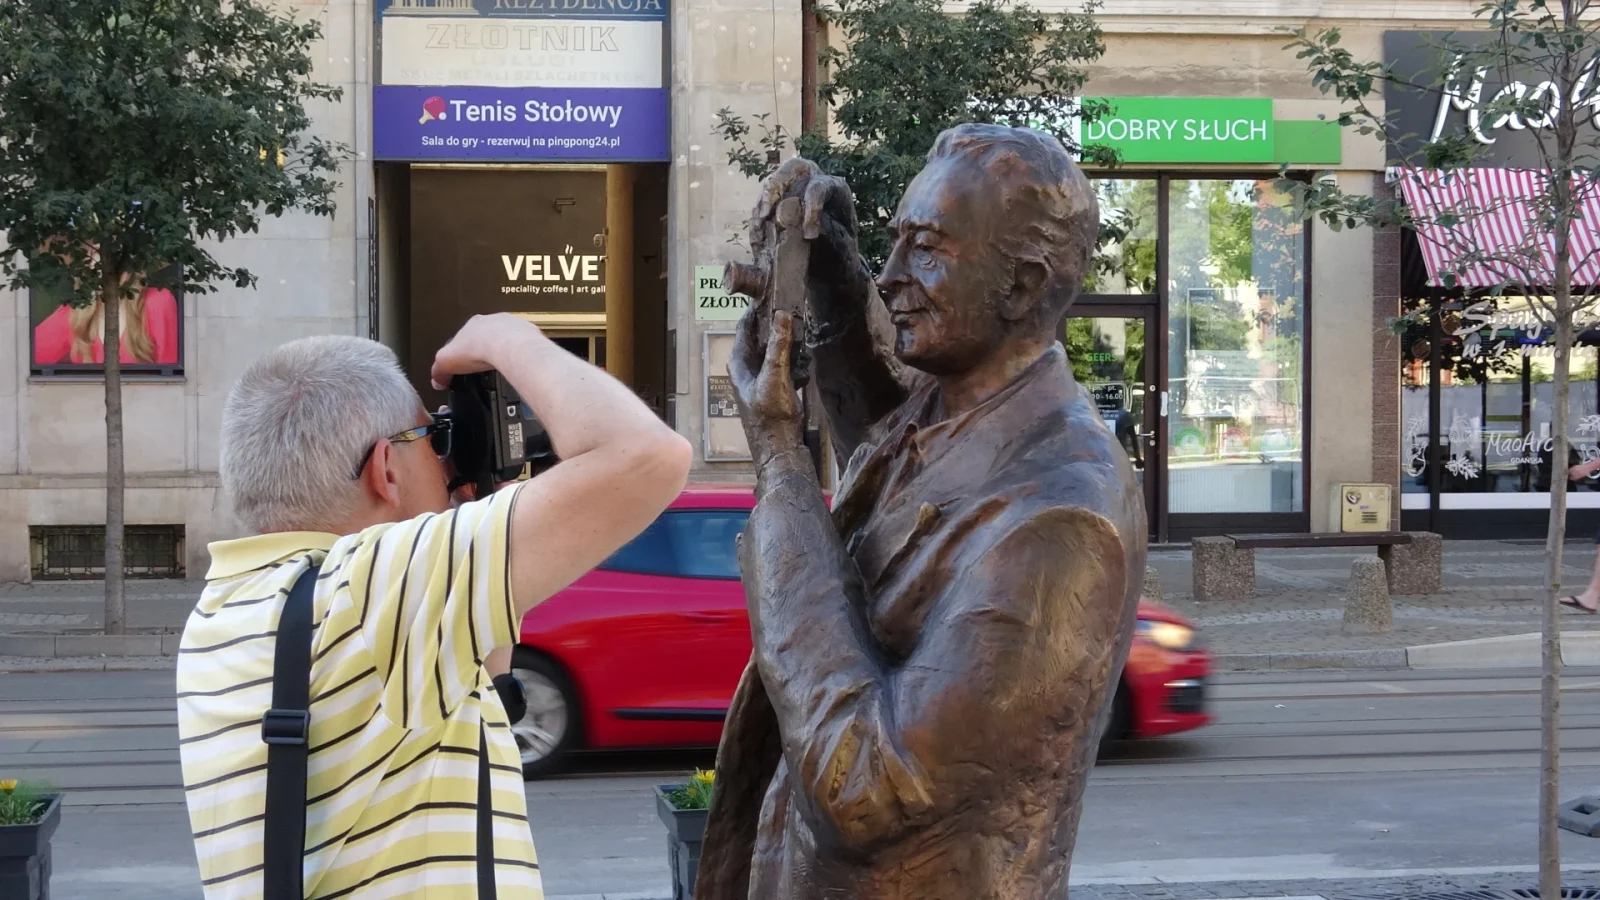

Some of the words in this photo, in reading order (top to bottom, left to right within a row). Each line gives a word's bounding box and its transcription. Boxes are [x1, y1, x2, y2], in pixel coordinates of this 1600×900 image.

[425, 23, 619, 51] ZŁOTNIK
[450, 100, 517, 122] Tenis
[524, 99, 623, 128] Stołowy
[1088, 119, 1178, 140] DOBRY
[1183, 118, 1267, 141] SŁUCH
[421, 136, 444, 146] Sala
[446, 136, 458, 146] do
[462, 138, 478, 148] gry
[487, 136, 530, 148] rezerwuj
[533, 138, 545, 146] na
[547, 136, 620, 148] pingpong24.pl
[501, 255, 607, 281] VELVE
[501, 285, 540, 294] speciality
[542, 285, 568, 293] coffee
[576, 285, 589, 293] art
[590, 285, 606, 294] gall
[700, 296, 749, 308] ZŁOTN
[1086, 352, 1117, 362] GEERS
